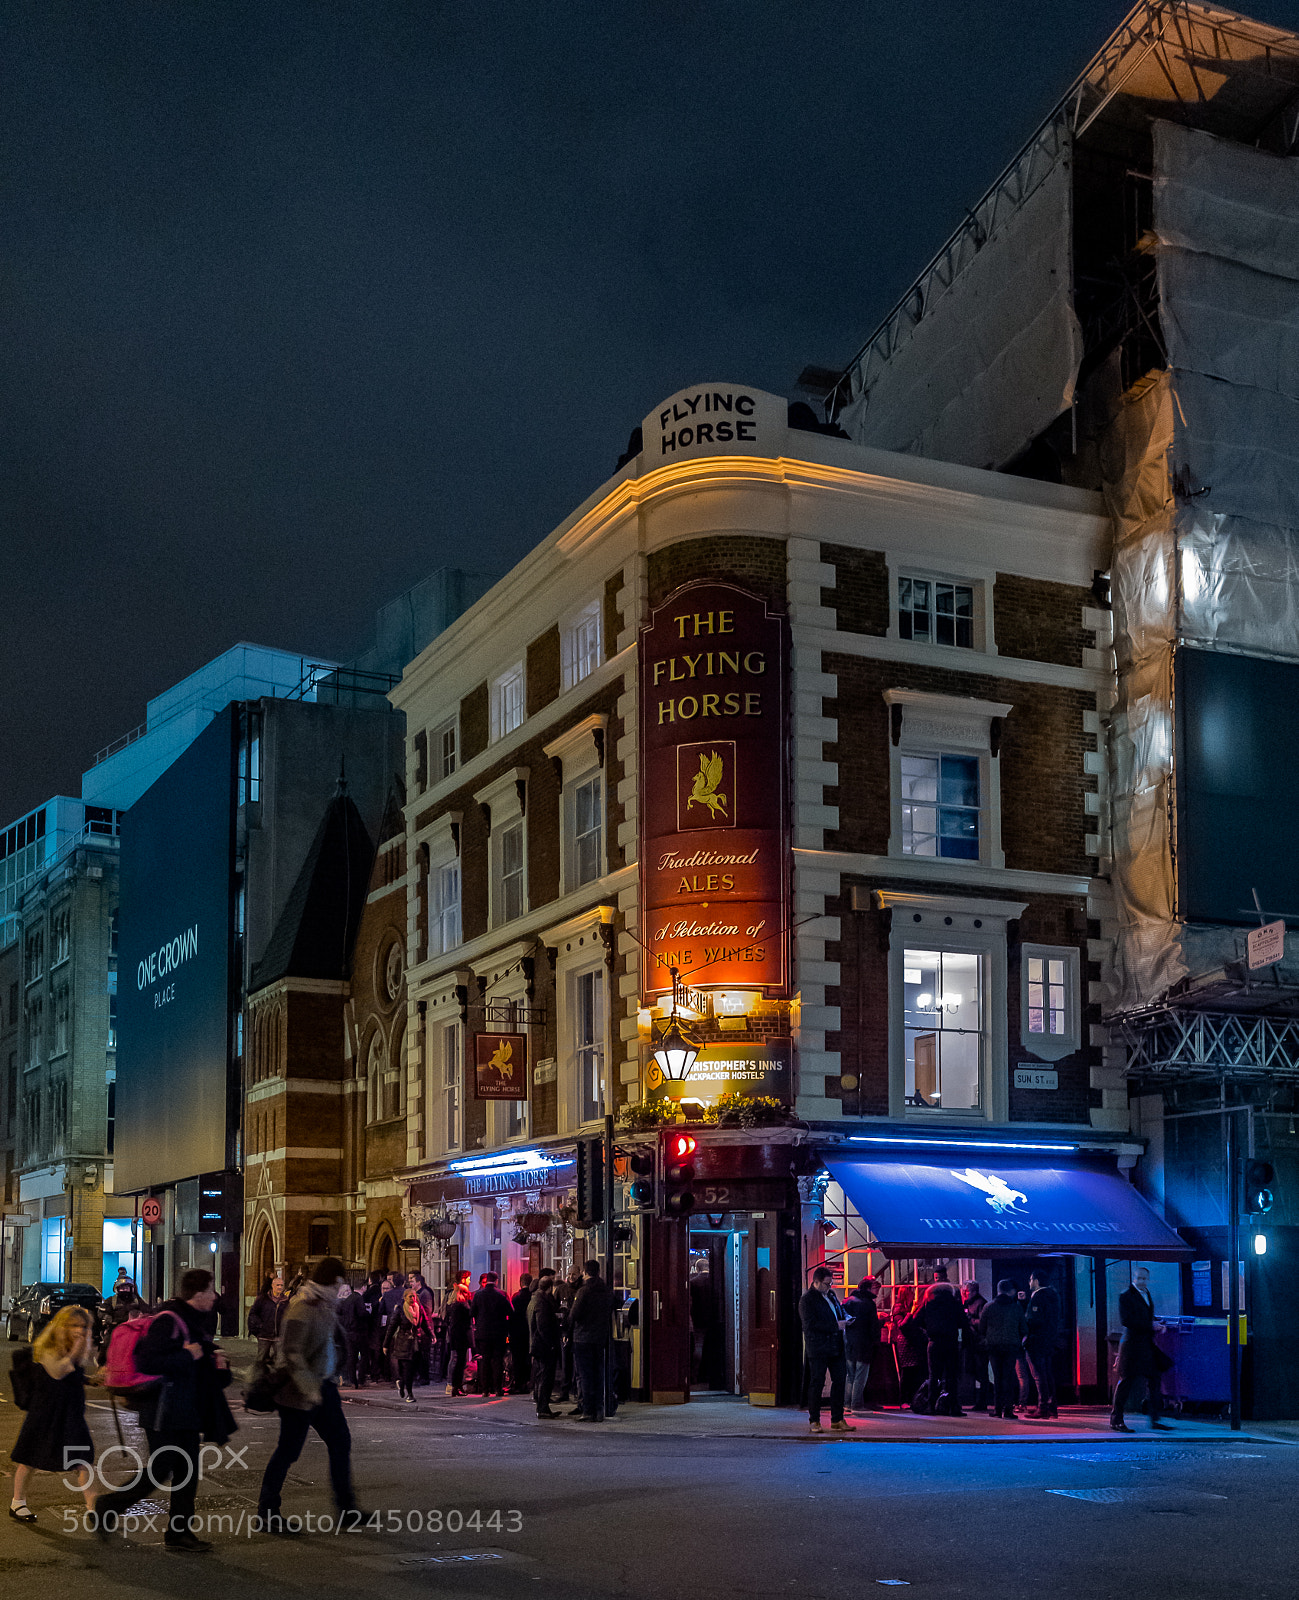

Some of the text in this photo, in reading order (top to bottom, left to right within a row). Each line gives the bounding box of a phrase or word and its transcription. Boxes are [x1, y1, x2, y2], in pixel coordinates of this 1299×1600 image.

[660, 392, 756, 430] FLYING
[661, 420, 757, 454] HORSE
[673, 610, 735, 638] THE
[653, 651, 766, 686] FLYING
[657, 692, 762, 725] HORSE
[657, 848, 760, 871] Traditional
[676, 873, 735, 894] ALES
[654, 919, 766, 941] A Selection of
[137, 923, 198, 991] ONE CROWN
[655, 946, 766, 968] FINE WINES
[154, 982, 176, 1010] PLACE
[731, 1071, 765, 1081] HOSTELS
[758, 1060, 783, 1071] INNS
[1017, 1074, 1032, 1084] SUN
[465, 1168, 550, 1195] THE FLYING HORSE
[704, 1187, 730, 1204] 52
[144, 1205, 159, 1217] 20
[919, 1218, 1125, 1233] THE FLYING HORSE
